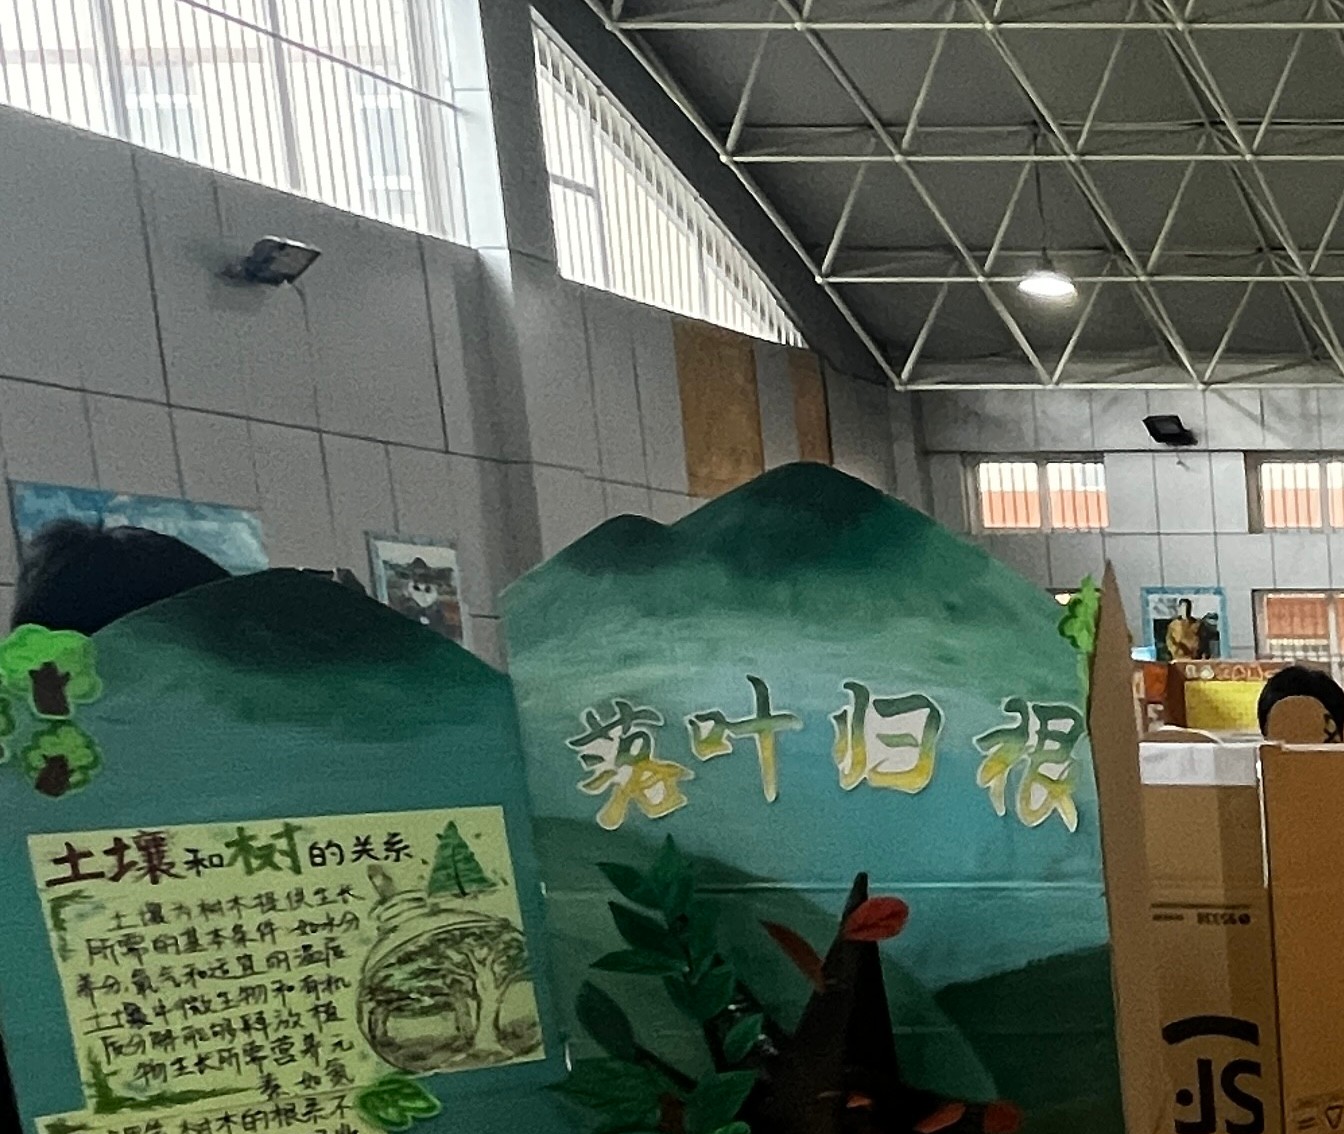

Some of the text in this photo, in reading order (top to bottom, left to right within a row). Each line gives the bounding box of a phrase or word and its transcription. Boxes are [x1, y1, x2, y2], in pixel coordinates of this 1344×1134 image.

[566, 674, 1084, 832] 落叶归根
[44, 822, 414, 887] 土壤和树的关系
